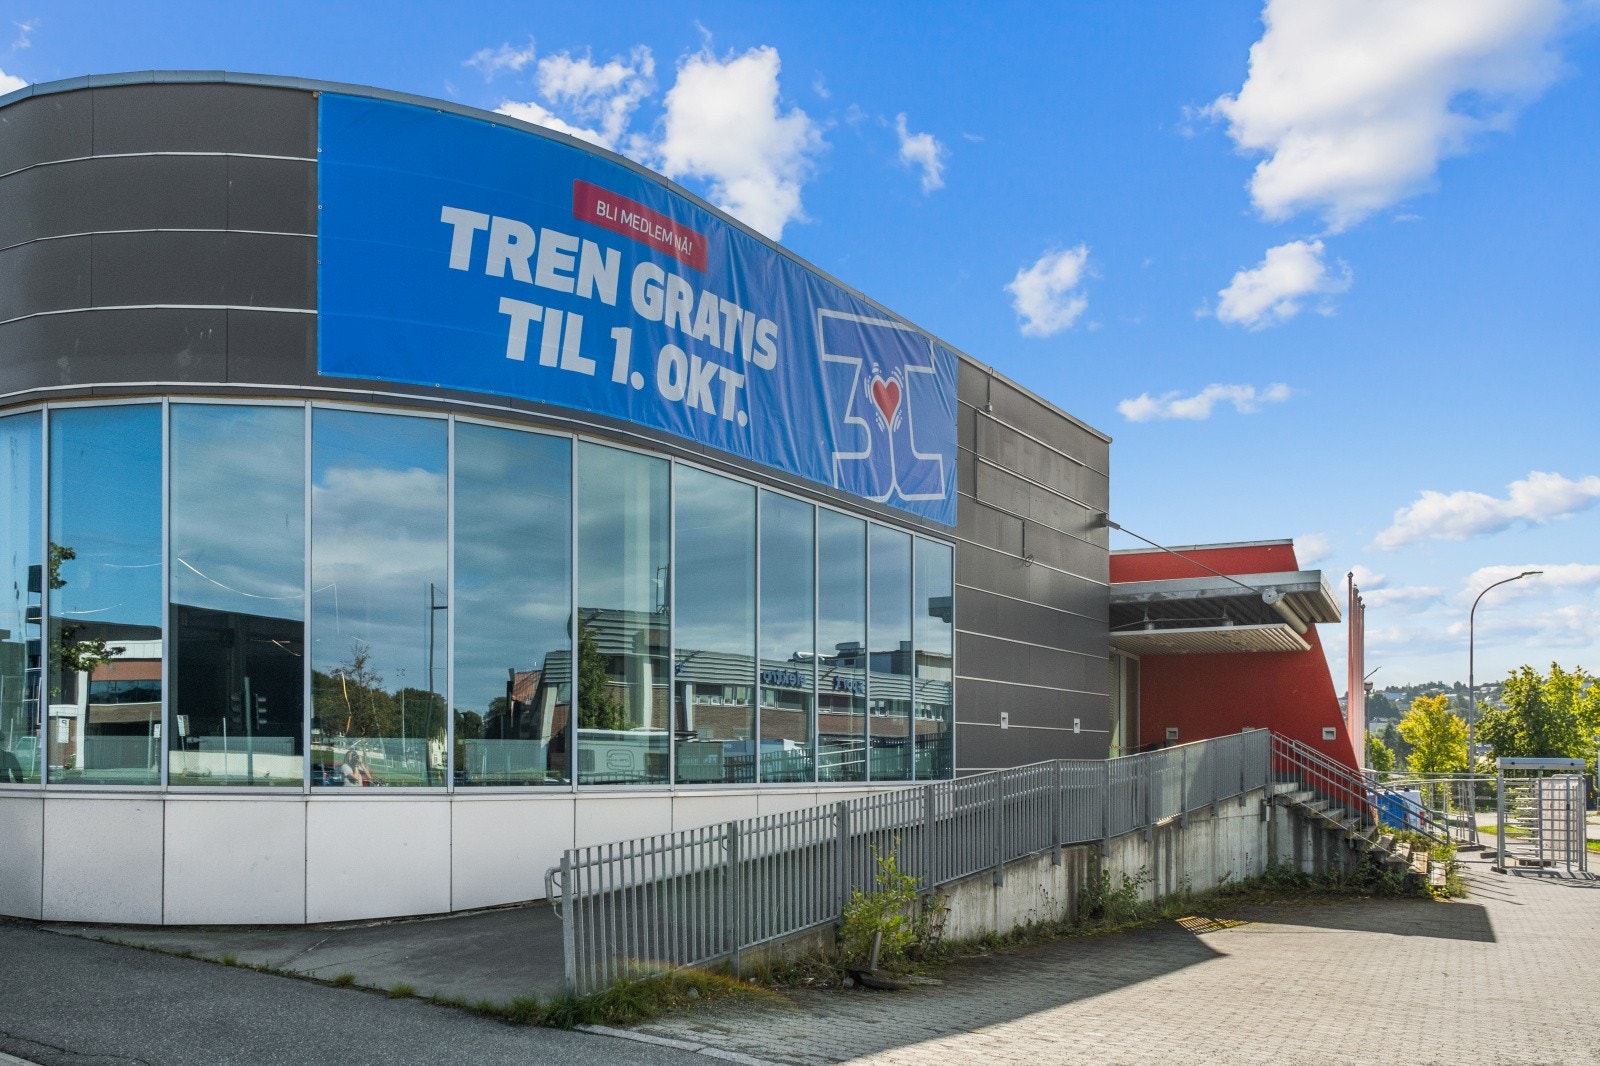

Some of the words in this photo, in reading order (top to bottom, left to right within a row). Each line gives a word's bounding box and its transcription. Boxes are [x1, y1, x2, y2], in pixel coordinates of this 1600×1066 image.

[440, 205, 622, 306] TREN
[630, 261, 778, 371] GRATIS
[596, 200, 618, 221] BLI
[620, 209, 673, 246] MEDLEM
[674, 236, 693, 255] NÅ!
[498, 296, 596, 376] TIL
[610, 326, 645, 390] 1.
[656, 343, 748, 427] OKT.
